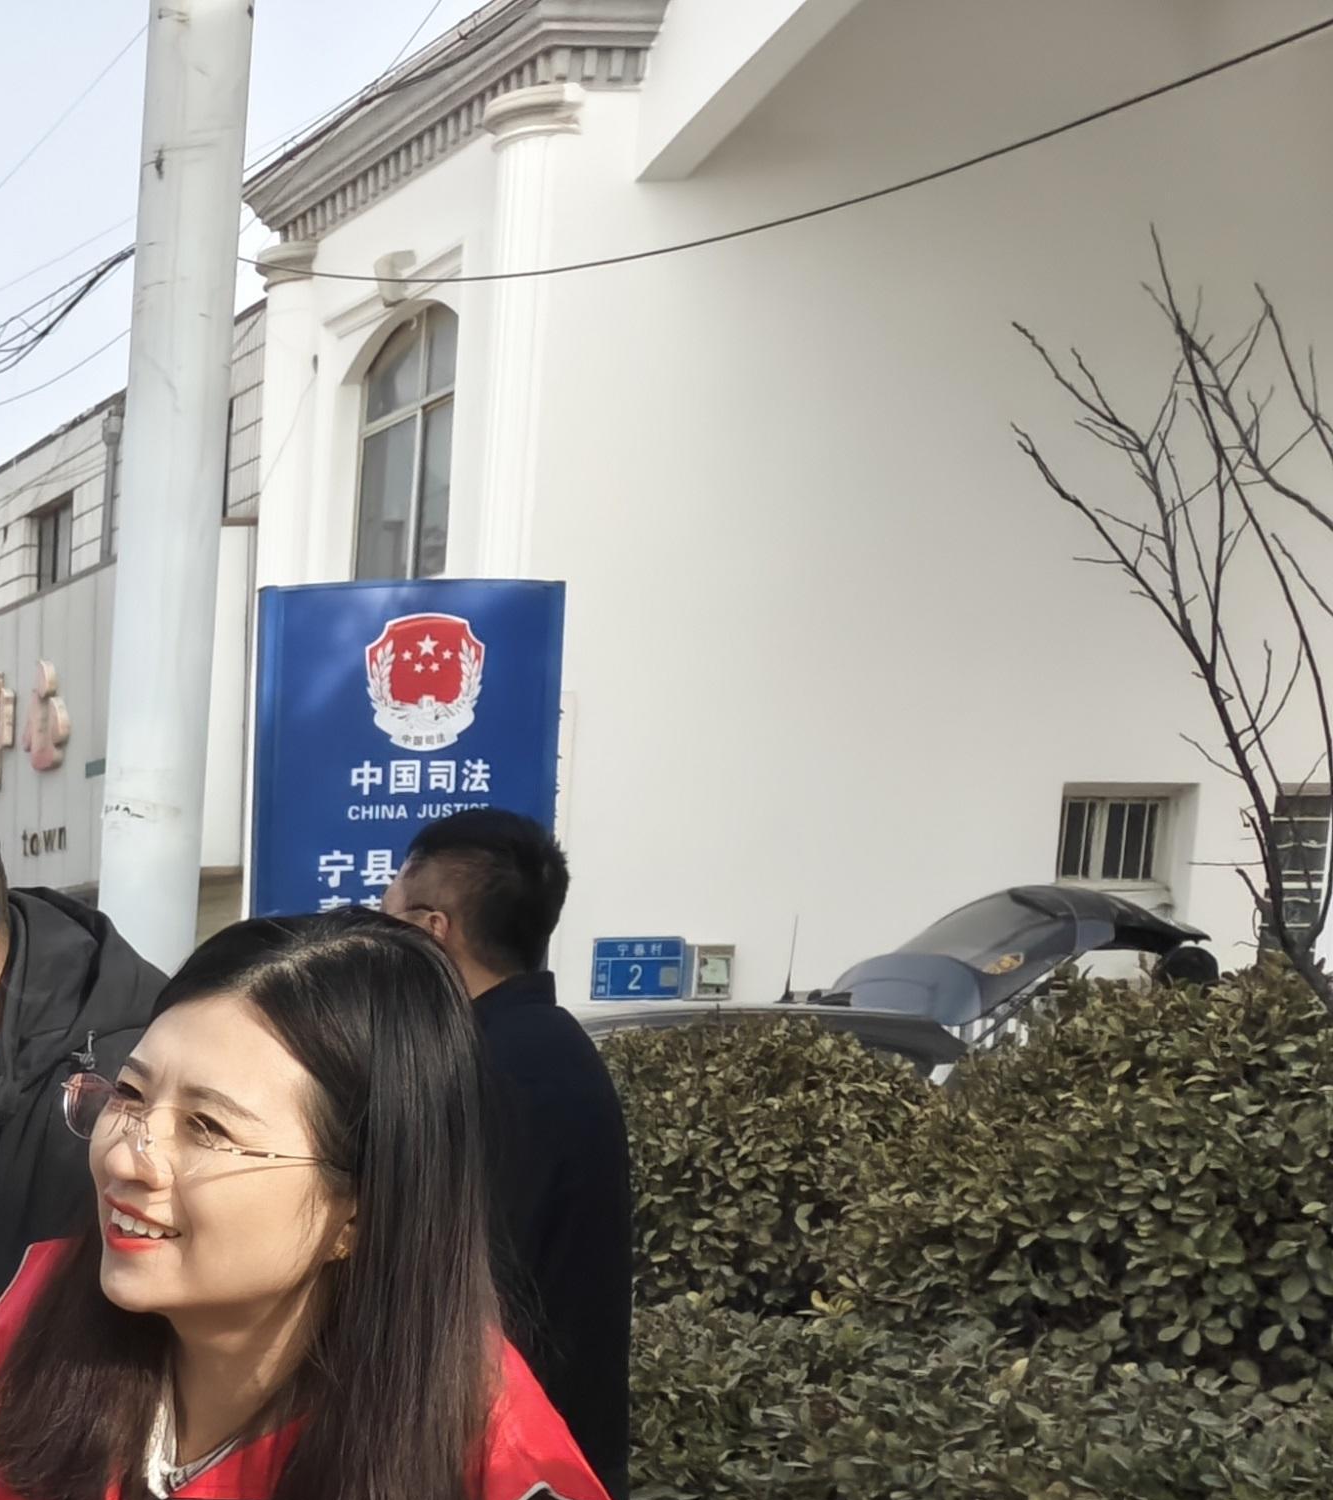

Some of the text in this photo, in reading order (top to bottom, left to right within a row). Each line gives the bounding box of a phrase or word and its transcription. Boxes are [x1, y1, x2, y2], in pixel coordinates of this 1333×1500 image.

[401, 732, 446, 746] 中国司法
[350, 759, 491, 796] 中国司法
[347, 803, 490, 821] CHINA JUST
[21, 825, 67, 857] town
[318, 849, 399, 888] 宁县
[627, 964, 643, 990] 2
